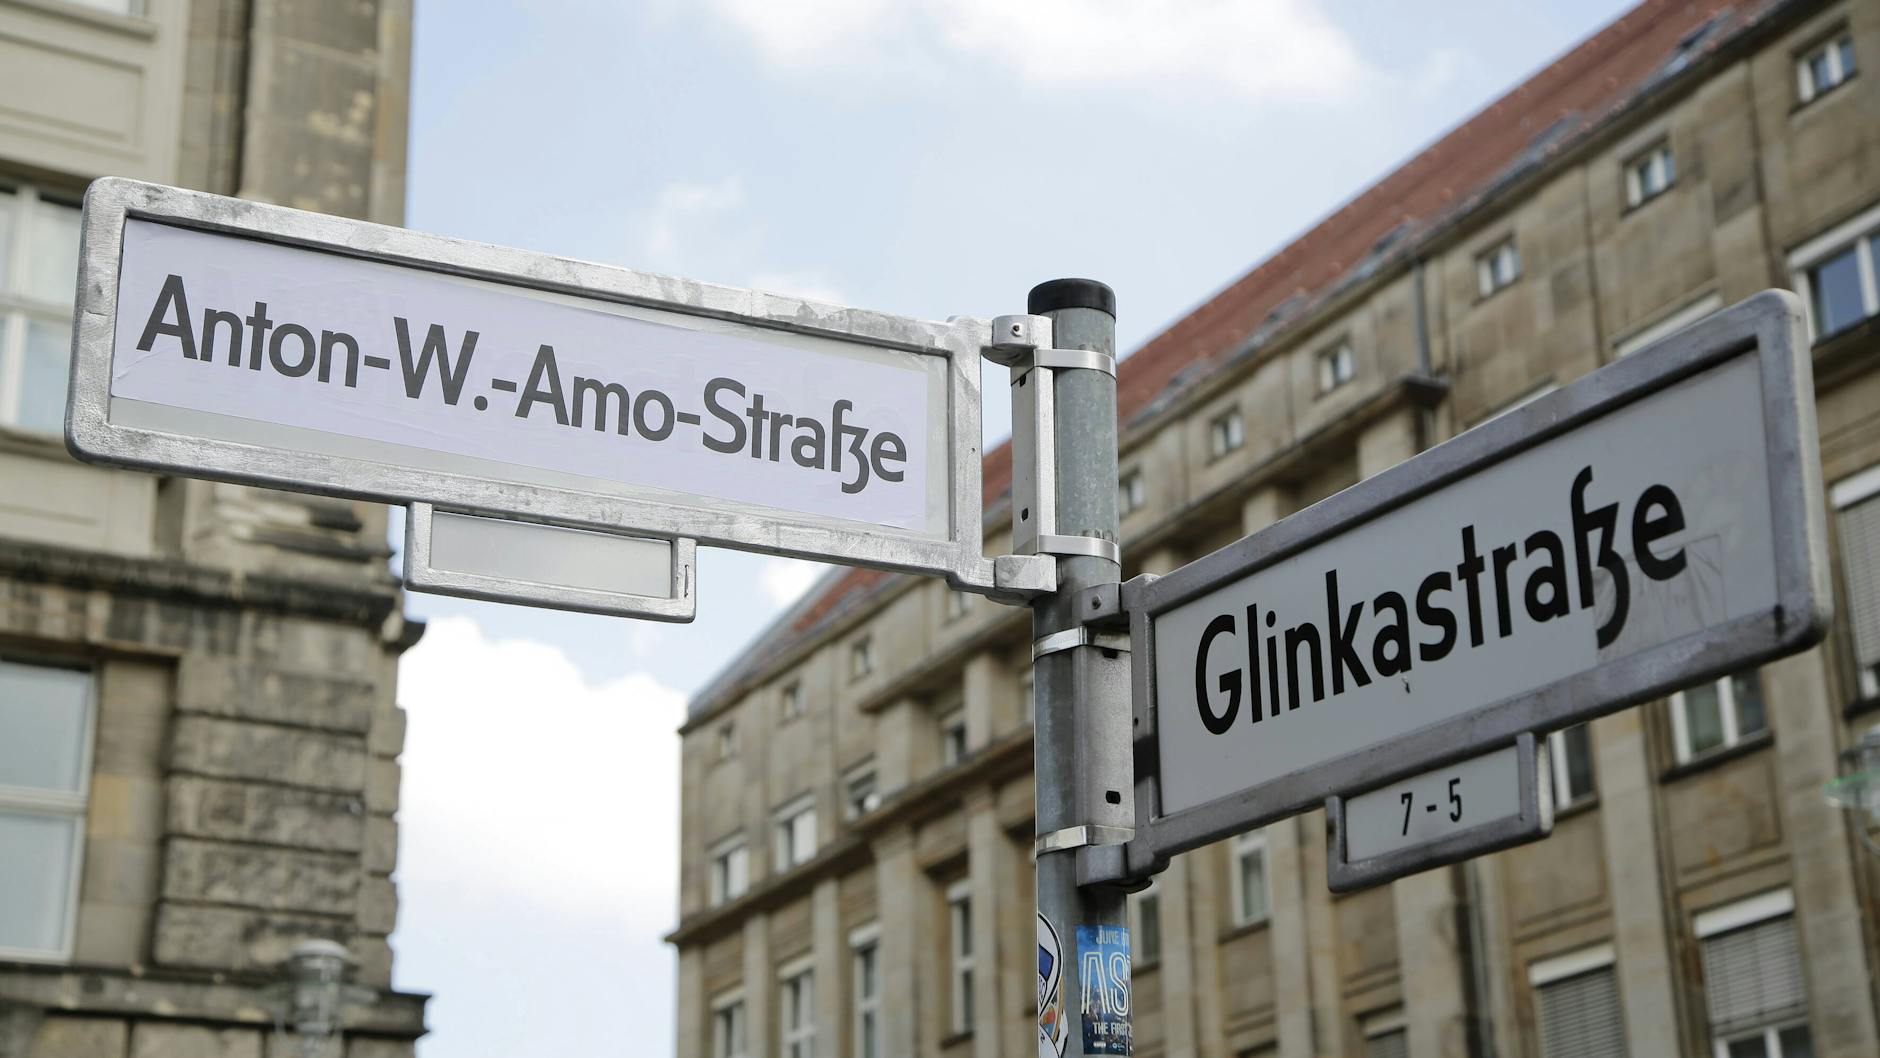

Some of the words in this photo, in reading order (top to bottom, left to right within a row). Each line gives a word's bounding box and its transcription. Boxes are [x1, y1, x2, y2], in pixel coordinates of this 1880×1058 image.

[136, 274, 907, 495] Anton-W.-Amo-Straße
[1195, 465, 1688, 736] Glinkastraße
[1095, 929, 1119, 946] JUNE
[1092, 1021, 1109, 1036] THE
